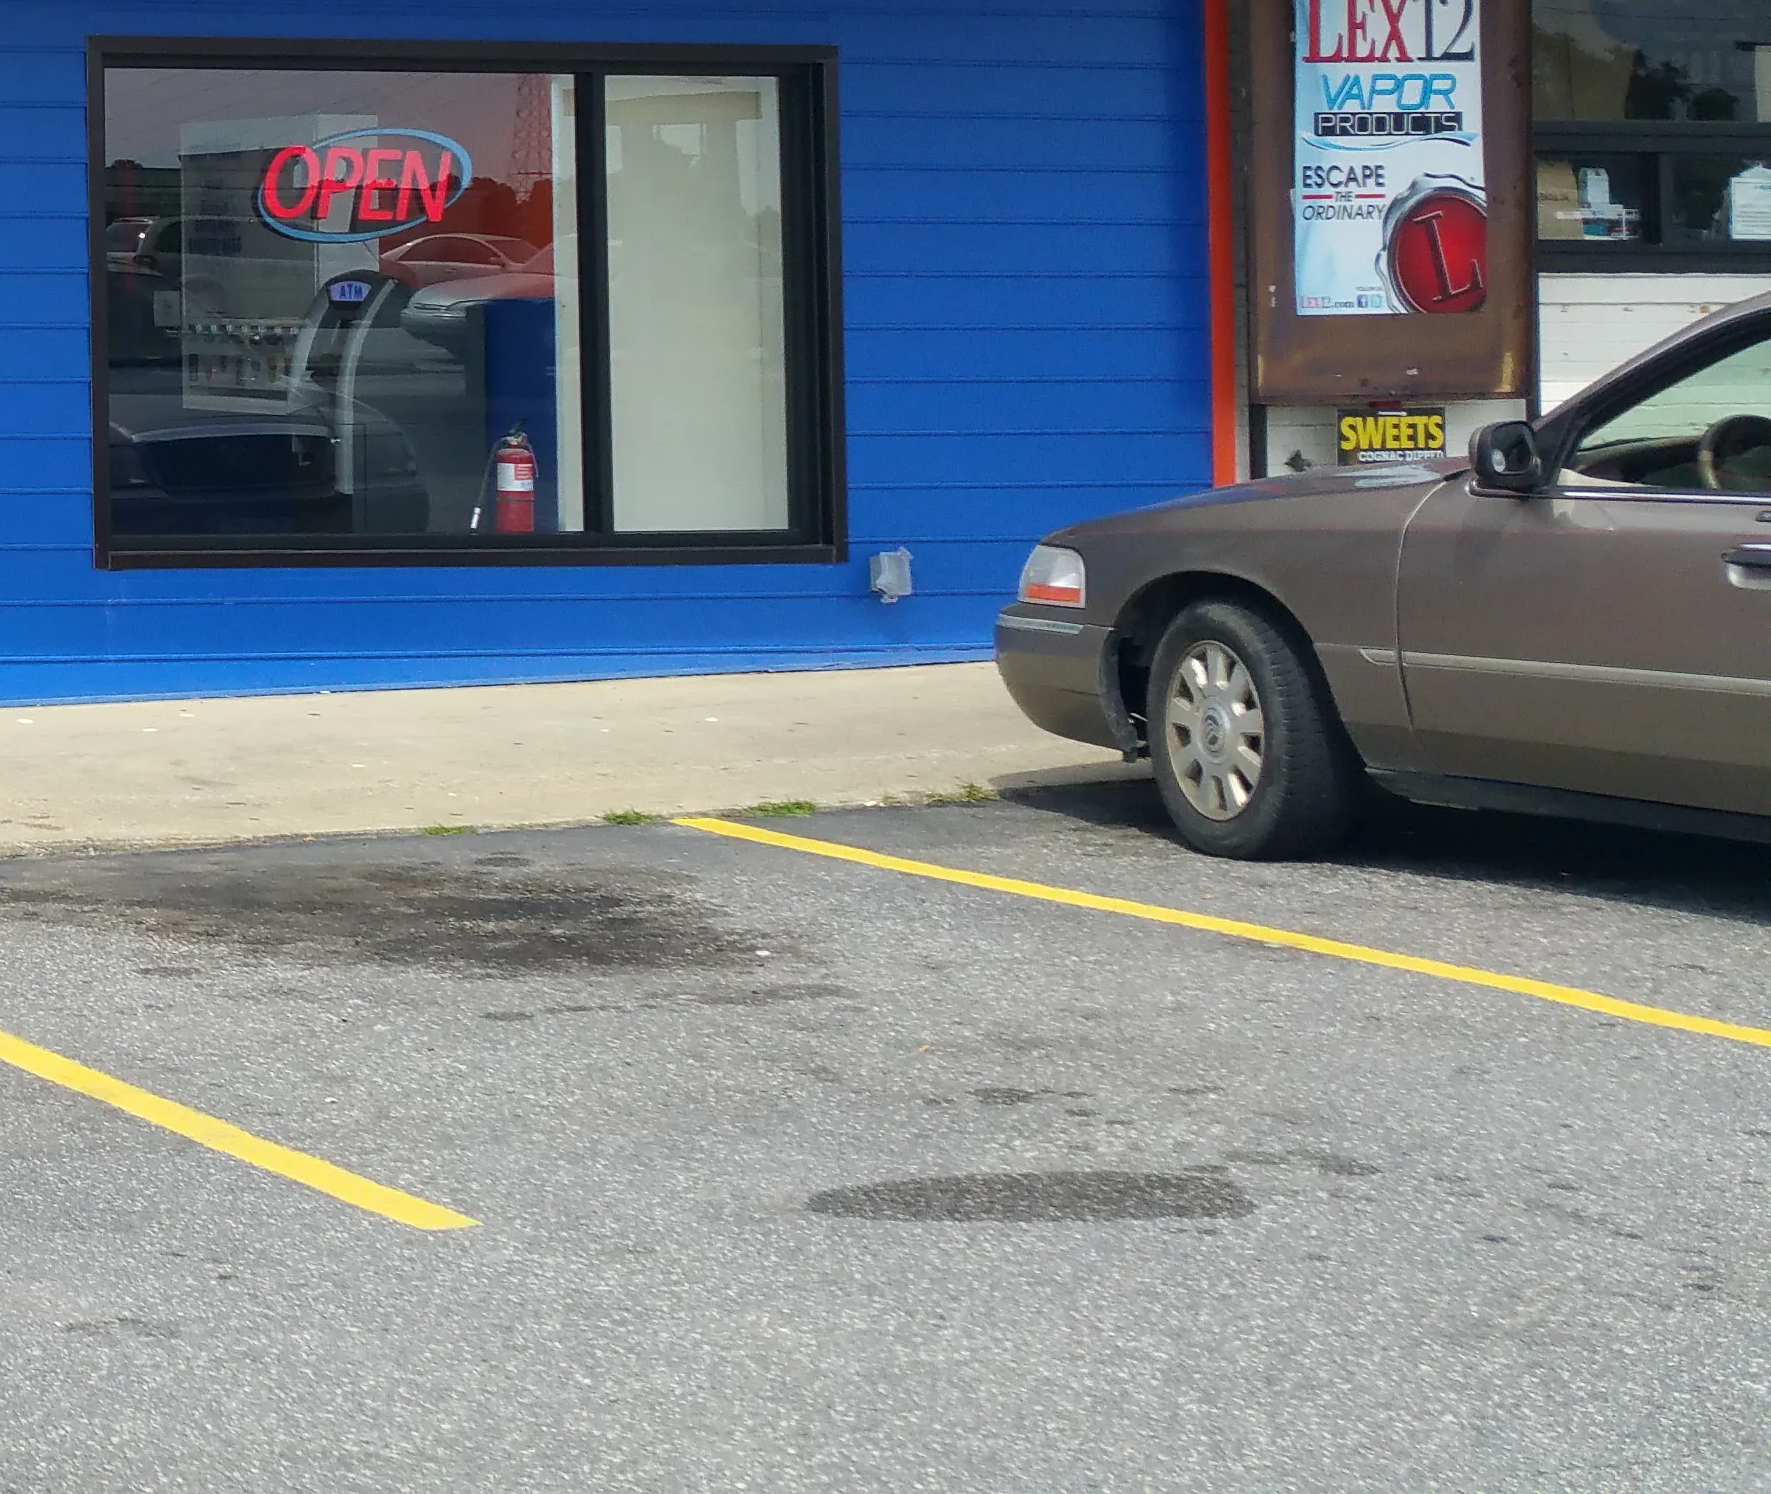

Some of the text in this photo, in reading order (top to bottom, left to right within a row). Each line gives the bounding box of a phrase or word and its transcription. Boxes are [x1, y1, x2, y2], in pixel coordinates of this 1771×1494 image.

[1322, 73, 1457, 110] VAPOR
[1317, 112, 1459, 136] PRODUCTS
[264, 145, 452, 222] OPEN
[1302, 165, 1386, 188] ESCAPE
[1333, 190, 1355, 202] THE
[1302, 204, 1386, 221] ORDINARY
[1412, 210, 1484, 303] L
[339, 283, 364, 299] ATM
[1340, 415, 1444, 450] SWEETS
[1358, 450, 1404, 461] COGNAC
